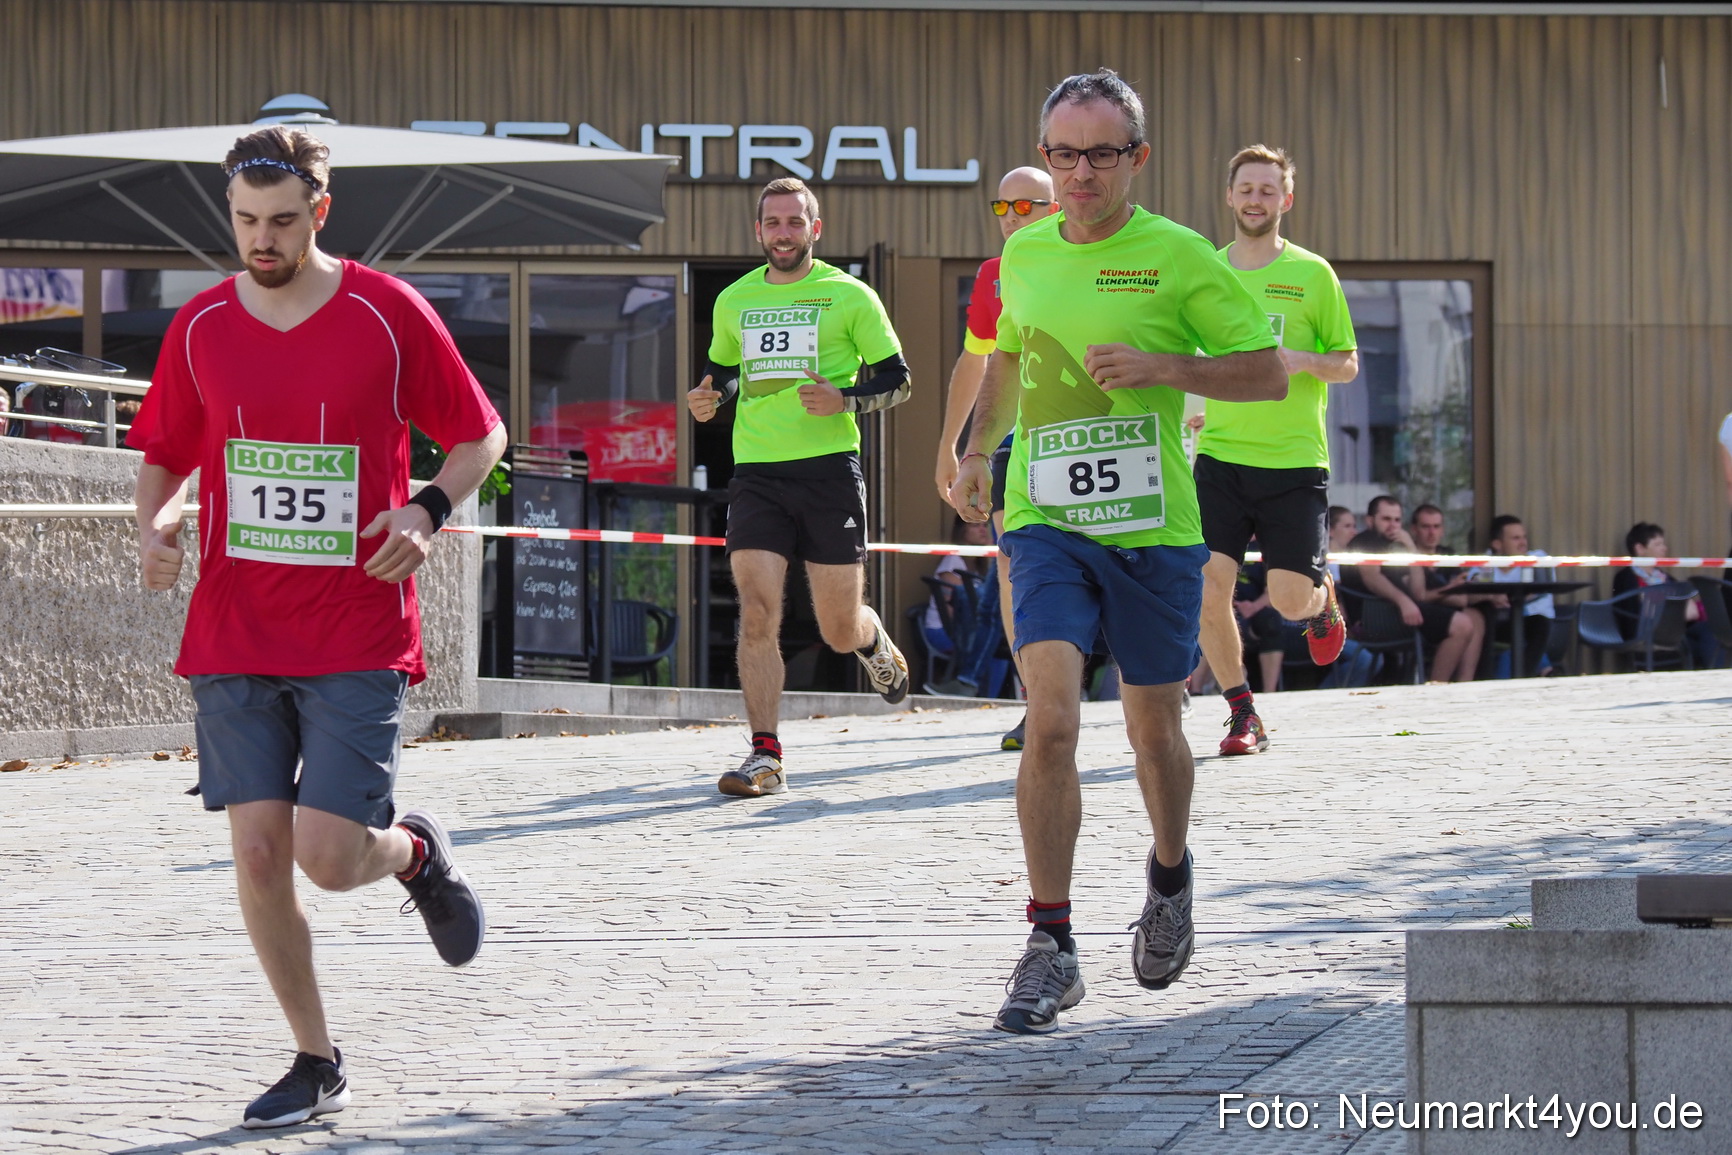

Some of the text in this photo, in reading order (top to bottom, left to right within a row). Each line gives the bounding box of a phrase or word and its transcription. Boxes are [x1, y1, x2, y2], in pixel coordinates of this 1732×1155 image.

[411, 120, 979, 182] NTRAL
[1096, 277, 1160, 286] ELEMENTELAUF
[1099, 269, 1159, 277] NEUMARKTER
[1265, 289, 1304, 298] ELEMENTELAUF
[744, 308, 813, 327] BOCK
[760, 331, 790, 353] 83
[751, 360, 809, 372] JOHANNES
[1038, 421, 1147, 457] BOCK
[234, 445, 346, 477] BOCK
[1068, 458, 1120, 496] 85
[251, 485, 326, 523] 135
[1065, 503, 1133, 522] FRANZ
[240, 529, 338, 551] PENIASKO
[523, 576, 556, 598] Espresso
